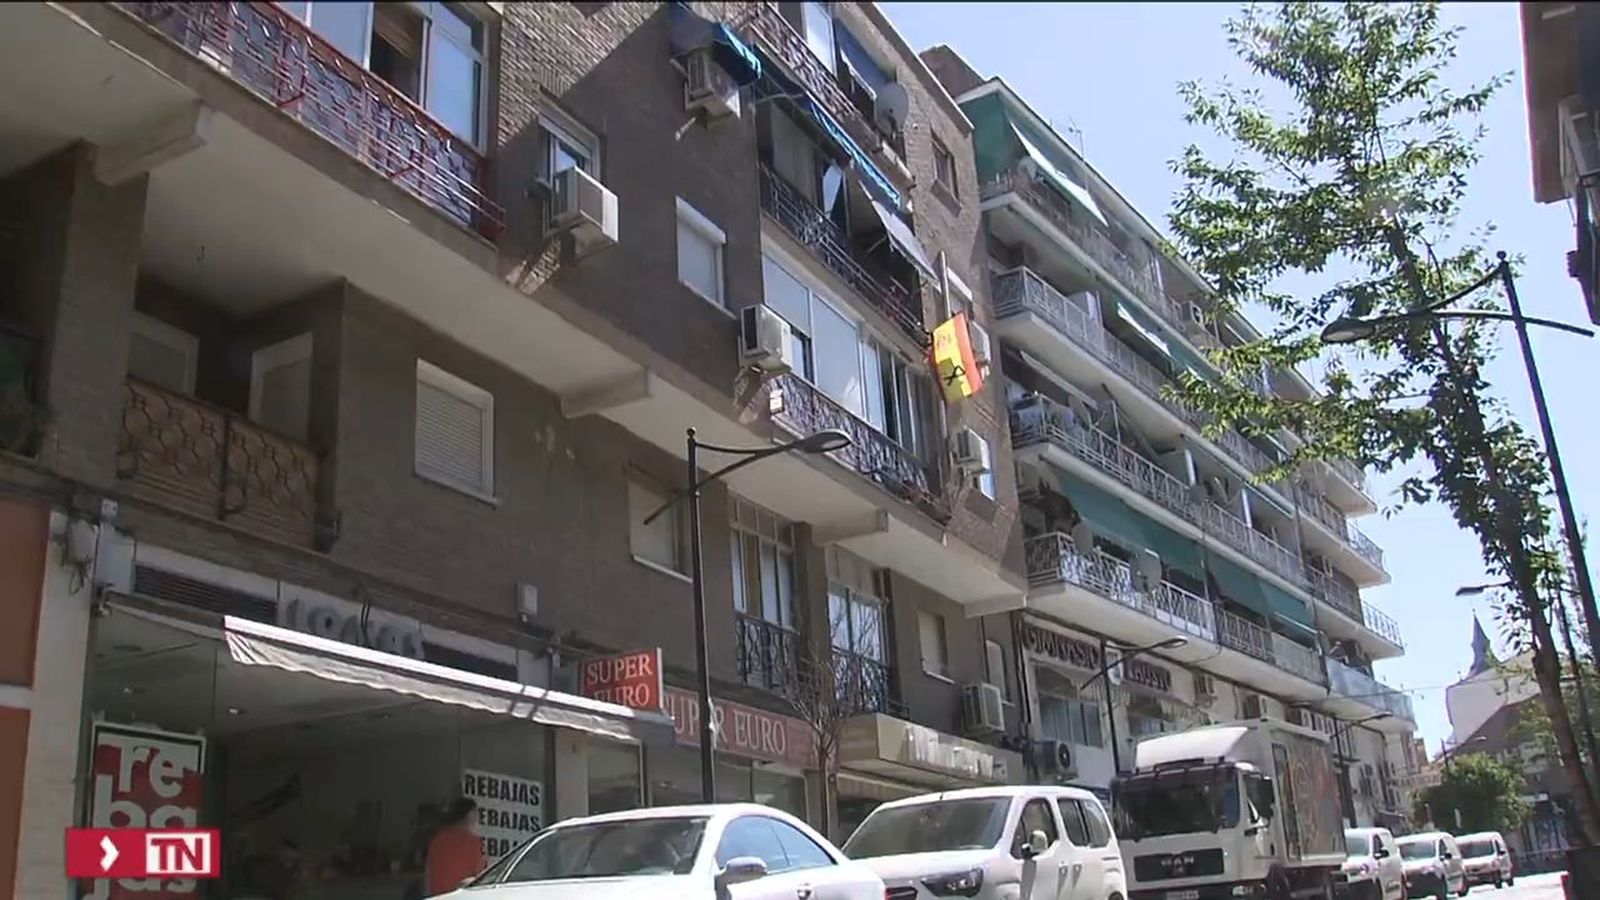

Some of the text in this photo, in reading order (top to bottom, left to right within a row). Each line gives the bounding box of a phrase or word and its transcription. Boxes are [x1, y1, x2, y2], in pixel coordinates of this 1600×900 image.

[587, 653, 653, 686] SUPER
[665, 691, 786, 755] UPR EURO
[465, 773, 540, 807] REBAJAS
[478, 807, 541, 832] EBAJAS
